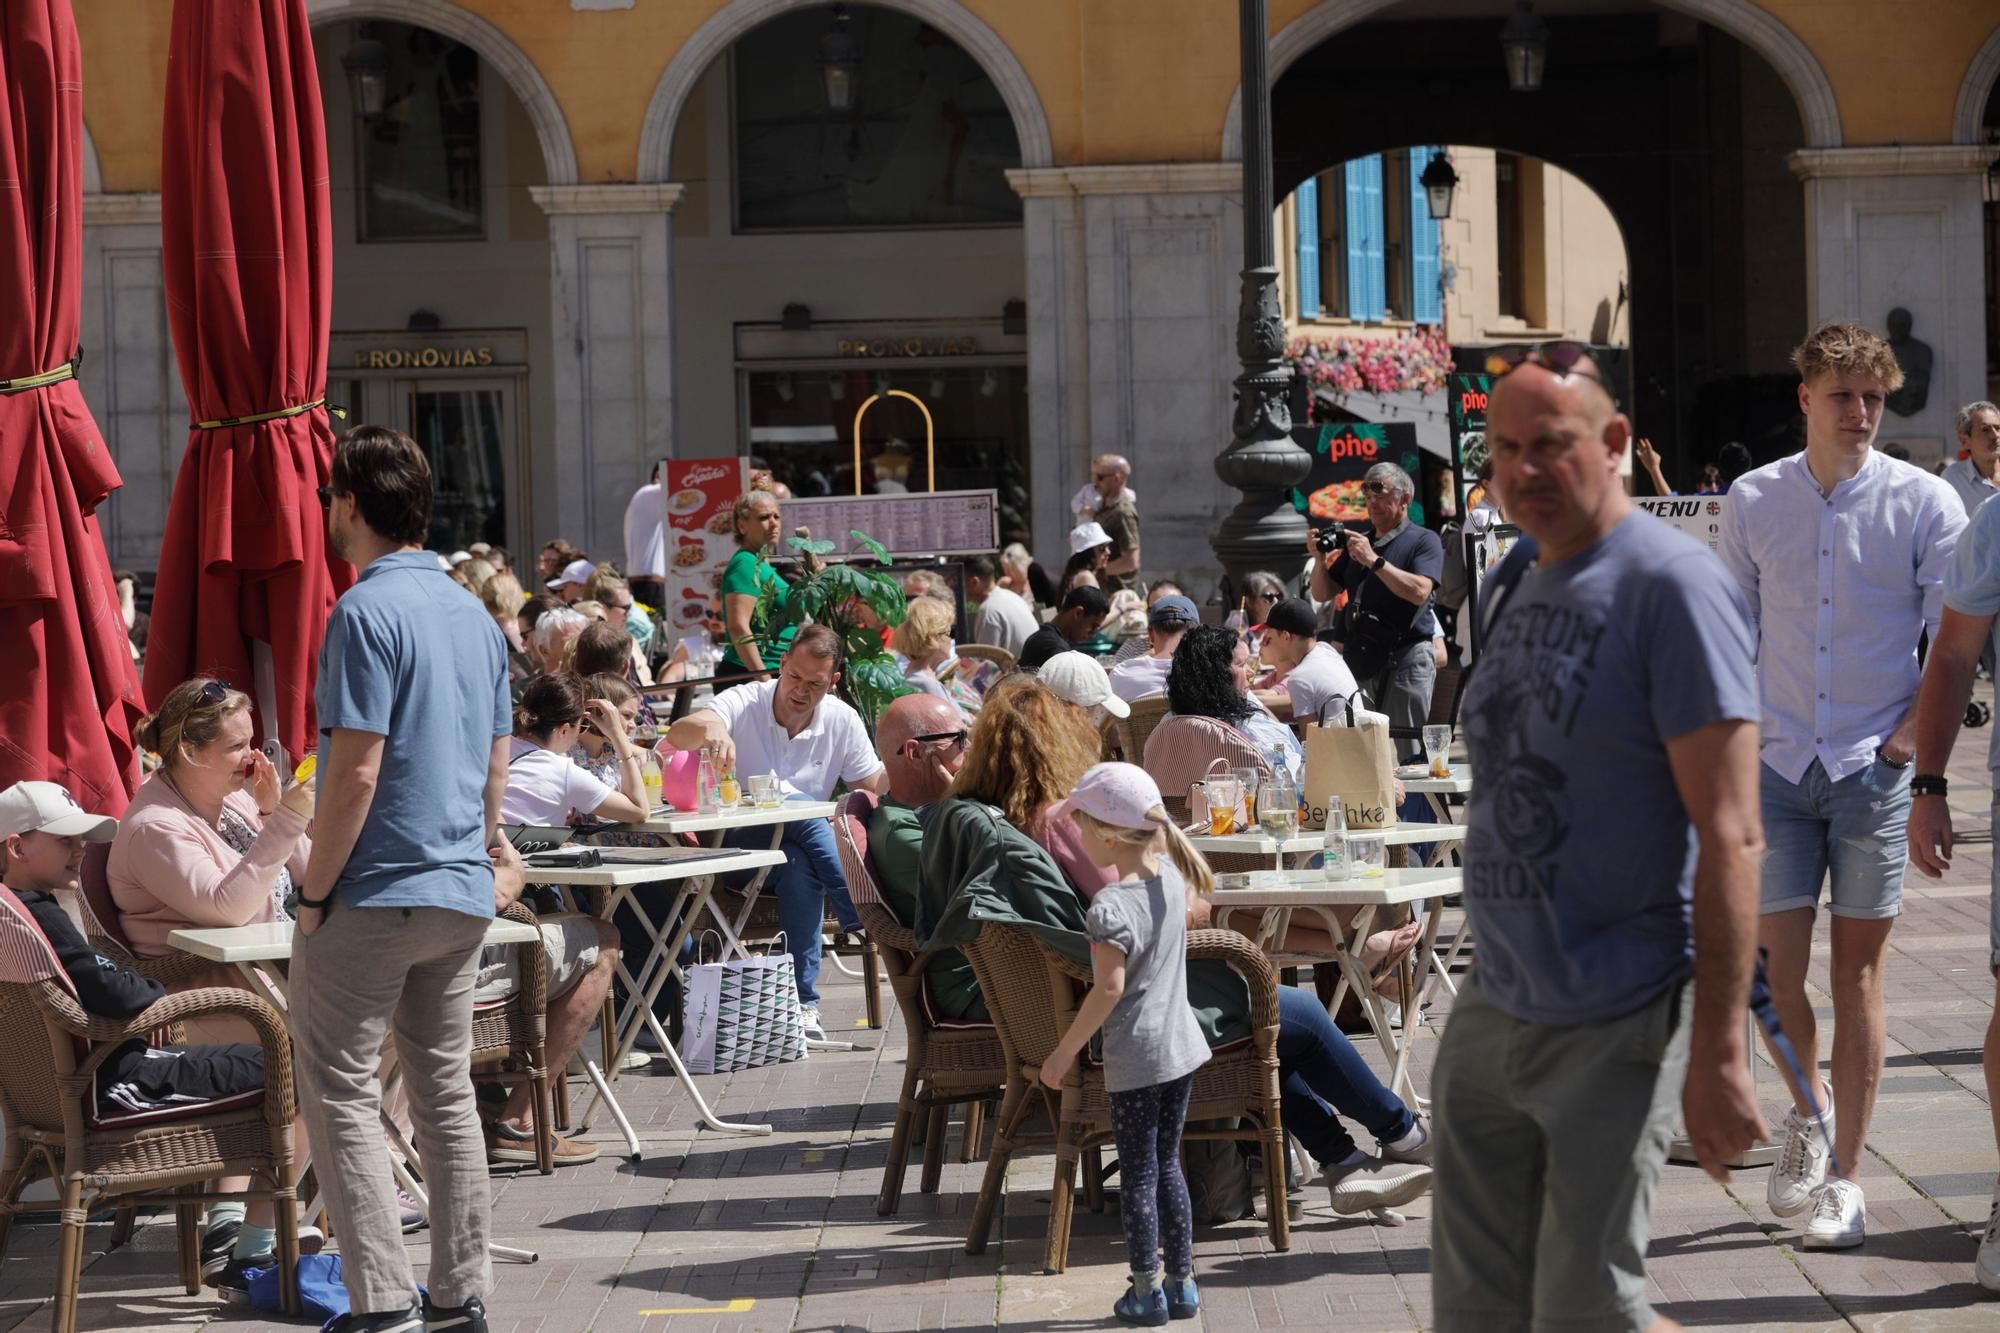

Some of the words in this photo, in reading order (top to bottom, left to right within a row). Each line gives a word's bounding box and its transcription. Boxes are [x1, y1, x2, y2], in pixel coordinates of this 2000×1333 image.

[354, 347, 493, 368] PRONOVIAS
[1639, 501, 1701, 517] MENU
[1497, 603, 1607, 669] STOM
[1304, 801, 1385, 824] Berhka
[1469, 861, 1560, 902] SION
